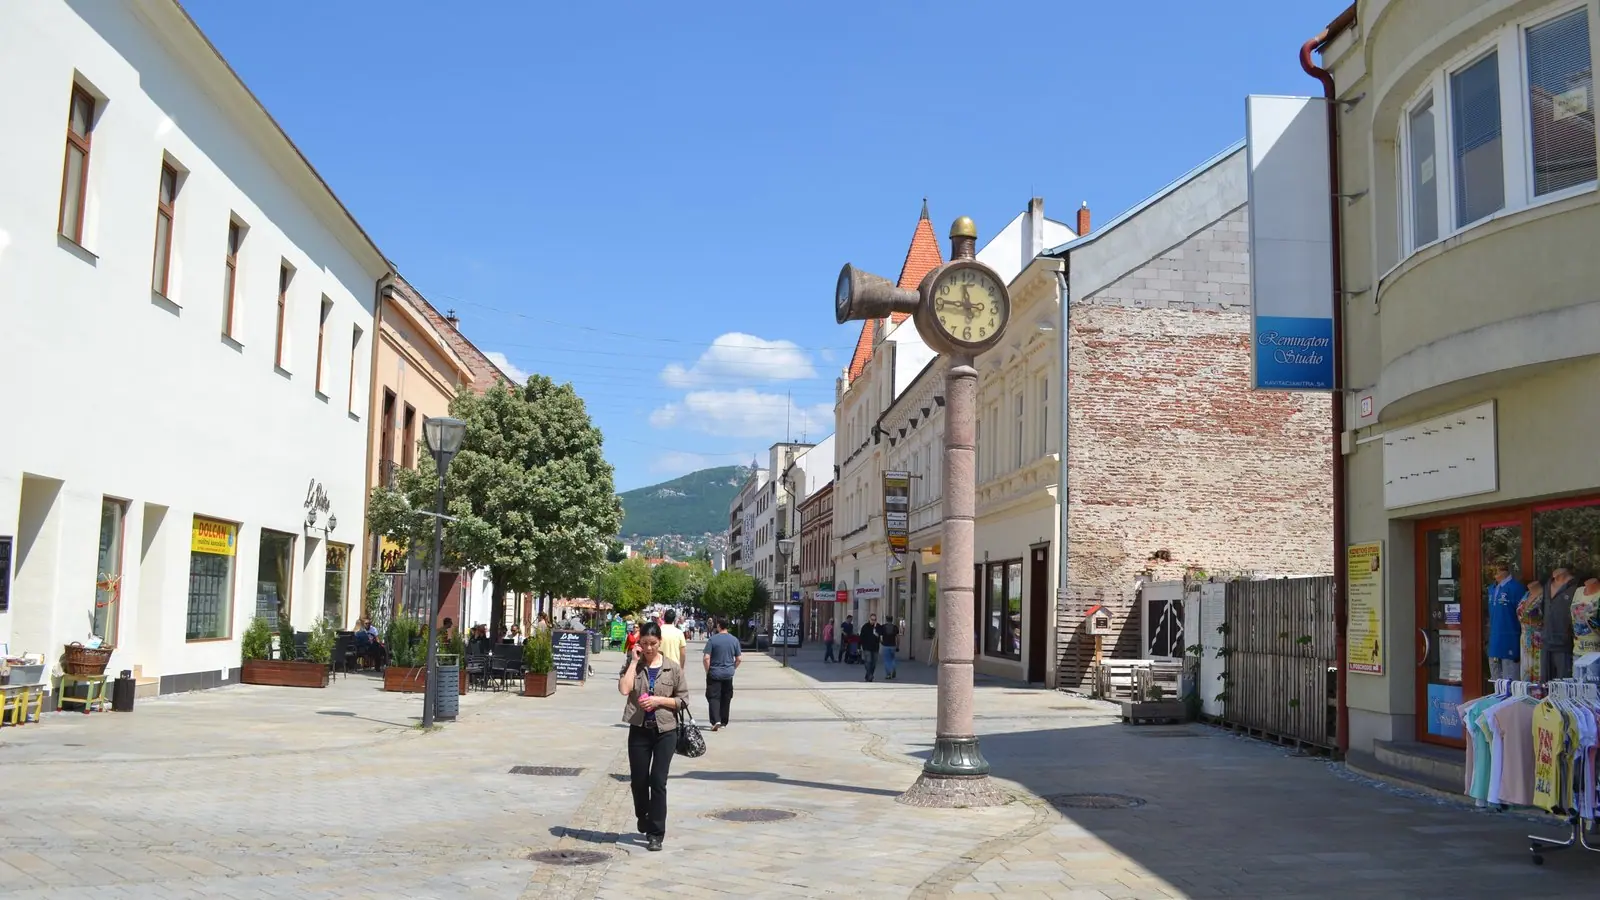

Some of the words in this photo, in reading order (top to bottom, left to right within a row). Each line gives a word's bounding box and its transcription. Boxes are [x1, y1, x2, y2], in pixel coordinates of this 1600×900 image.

[950, 275, 957, 285] 11
[962, 271, 975, 282] 12
[980, 277, 984, 288] 1
[940, 285, 950, 296] 10
[988, 286, 995, 297] 2
[936, 297, 945, 311] 9
[990, 301, 999, 315] 3
[939, 315, 947, 326] 8
[988, 317, 994, 328] 4
[950, 325, 957, 336] 7
[963, 327, 972, 340] 6
[979, 326, 986, 337] 5
[1258, 331, 1329, 351] Remington
[1273, 349, 1324, 365] Studio
